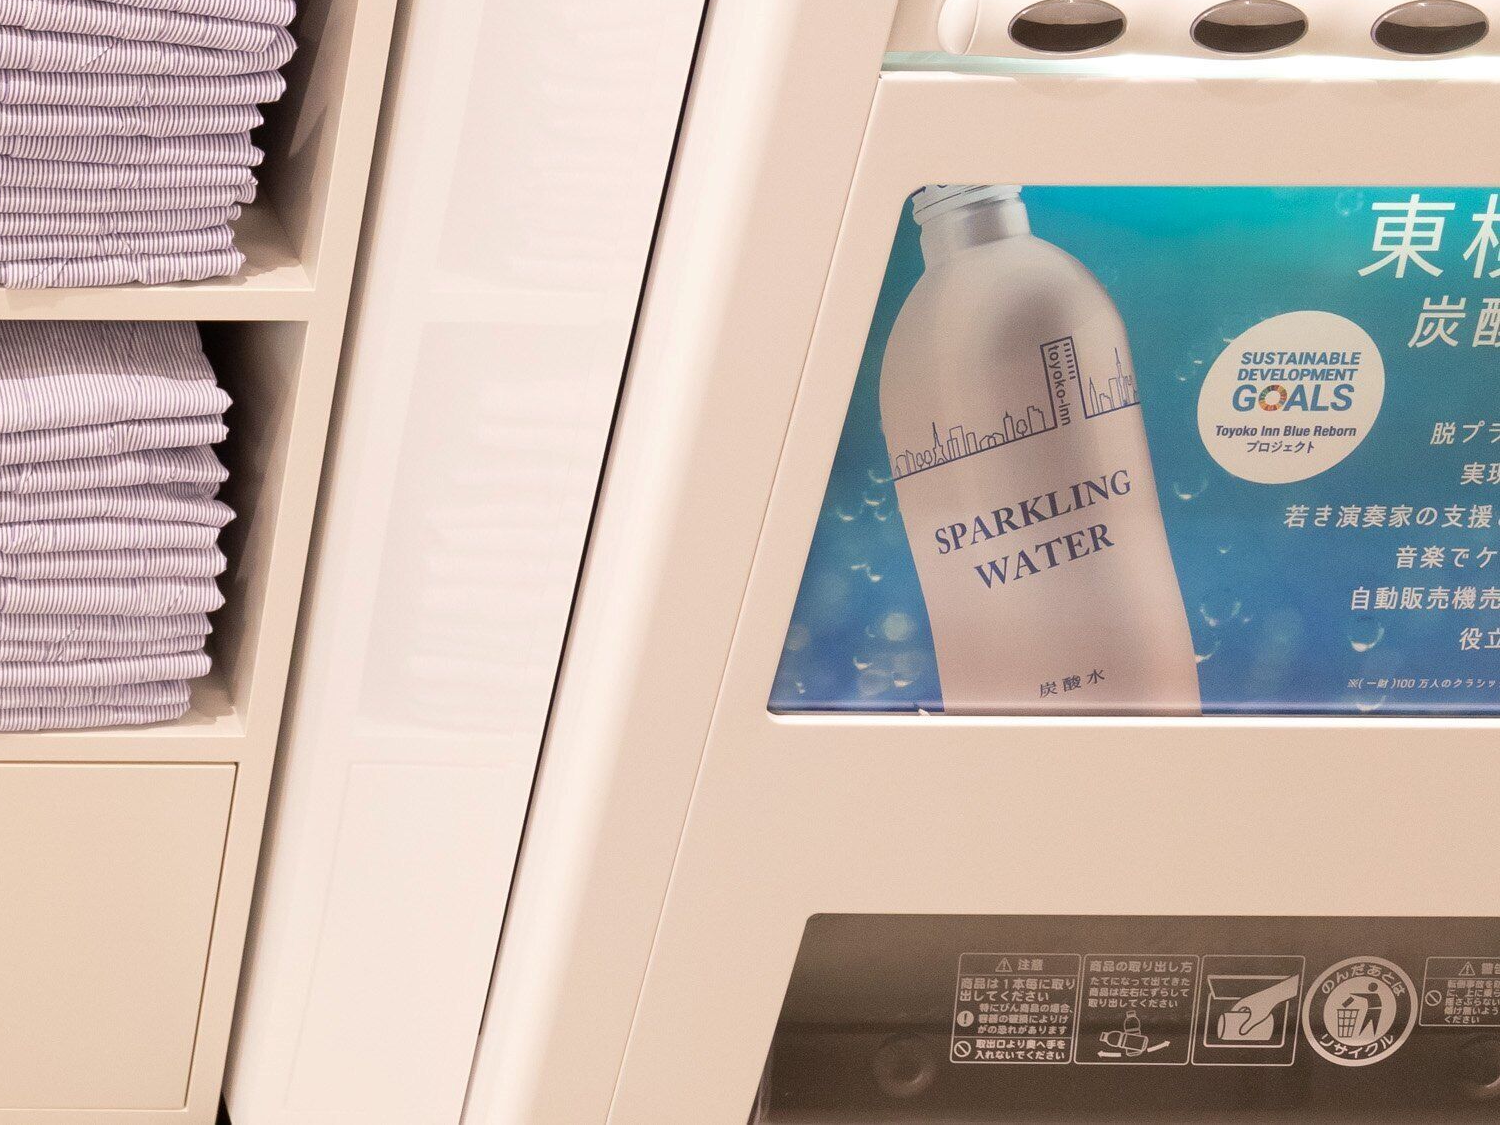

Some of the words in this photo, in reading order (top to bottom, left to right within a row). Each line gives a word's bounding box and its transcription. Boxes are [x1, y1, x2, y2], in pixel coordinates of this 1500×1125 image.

[1241, 352, 1361, 365] SUSTAINABLE
[1237, 369, 1358, 381] DEVELOPMENT
[1047, 342, 1072, 427] toyoko-inn
[1232, 384, 1355, 412] GOALS
[1215, 426, 1258, 438] Toyoko
[1261, 426, 1280, 436] Inn
[1283, 426, 1310, 437] Blue
[1313, 426, 1357, 437] Reborn
[1246, 441, 1315, 453] プロジェクト
[934, 469, 1132, 556] SPARKLING
[974, 523, 1115, 590] WATER
[1395, 545, 1498, 569] 音楽でケ
[1039, 667, 1107, 698] 炭酸水
[1090, 960, 1193, 973] 商品の取り出し方
[1090, 976, 1191, 986] たてになって出てきた
[1321, 963, 1407, 997] のんだあとは
[960, 990, 1049, 1002] 出してください
[1089, 987, 1190, 997] 商品は左右にずらして
[1088, 998, 1178, 1008] 取り出してください
[1444, 1015, 1480, 1024] ください
[1319, 1033, 1395, 1059] リサイクル
[974, 1050, 1065, 1060] 入れないでください
